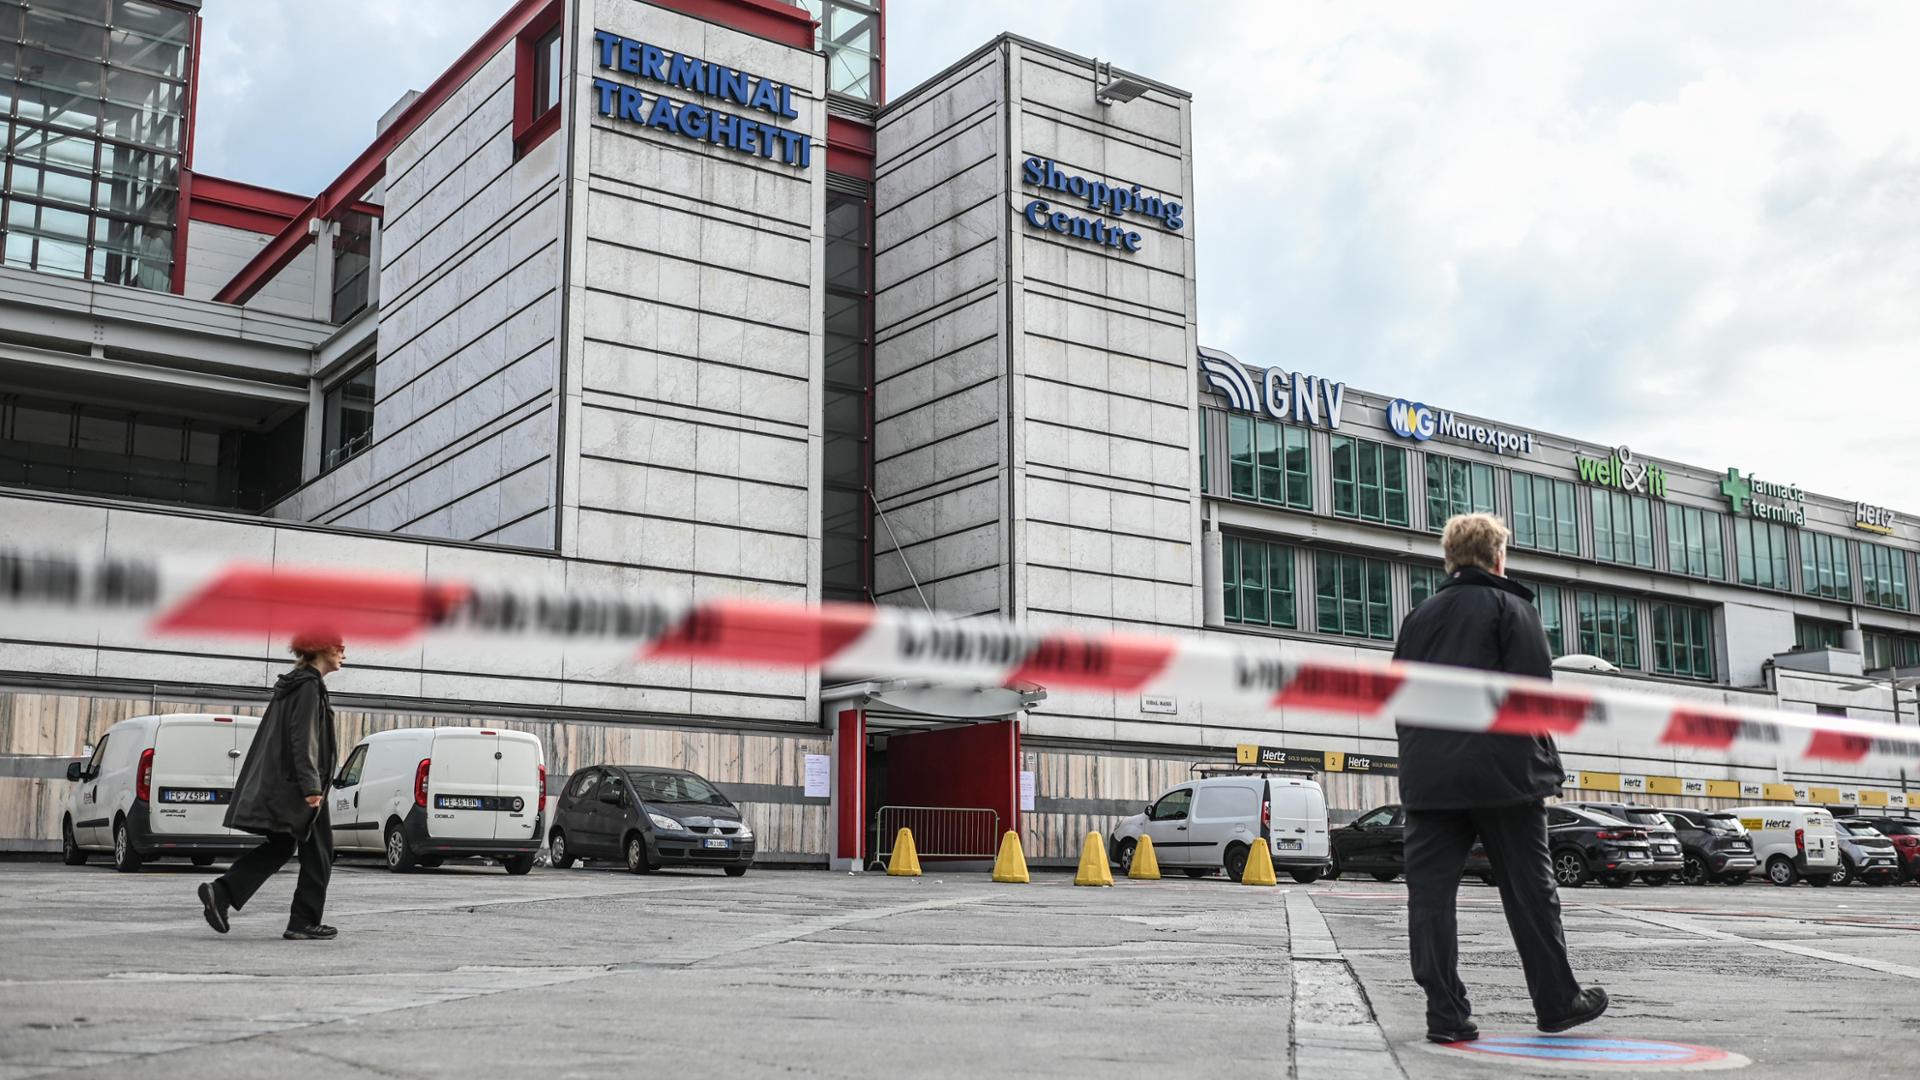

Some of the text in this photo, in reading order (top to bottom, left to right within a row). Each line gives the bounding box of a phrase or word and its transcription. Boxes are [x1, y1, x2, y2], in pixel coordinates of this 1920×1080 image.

[594, 29, 799, 120] TERMINAL
[594, 78, 812, 169] TRAGHETTI
[1023, 156, 1184, 231] Shopping
[1024, 199, 1143, 254] Centre
[1262, 365, 1346, 430] GNV
[1438, 410, 1533, 454] Marexport
[1749, 473, 1805, 502] farmacia
[1751, 498, 1807, 527] terminal
[1855, 501, 1896, 529] Hertz
[1244, 750, 1249, 759] 1
[1262, 749, 1287, 761] Hertz
[1330, 756, 1336, 766] 2
[1347, 756, 1371, 768] Hertz
[1584, 776, 1589, 785] 5
[1624, 777, 1654, 789] Hertz 6
[1685, 781, 1713, 793] Hertz 7
[1743, 785, 1760, 795] Hertz
[1842, 792, 1856, 801] Hertz
[1890, 795, 1904, 804] Hertz
[1765, 819, 1792, 829] Hertz
